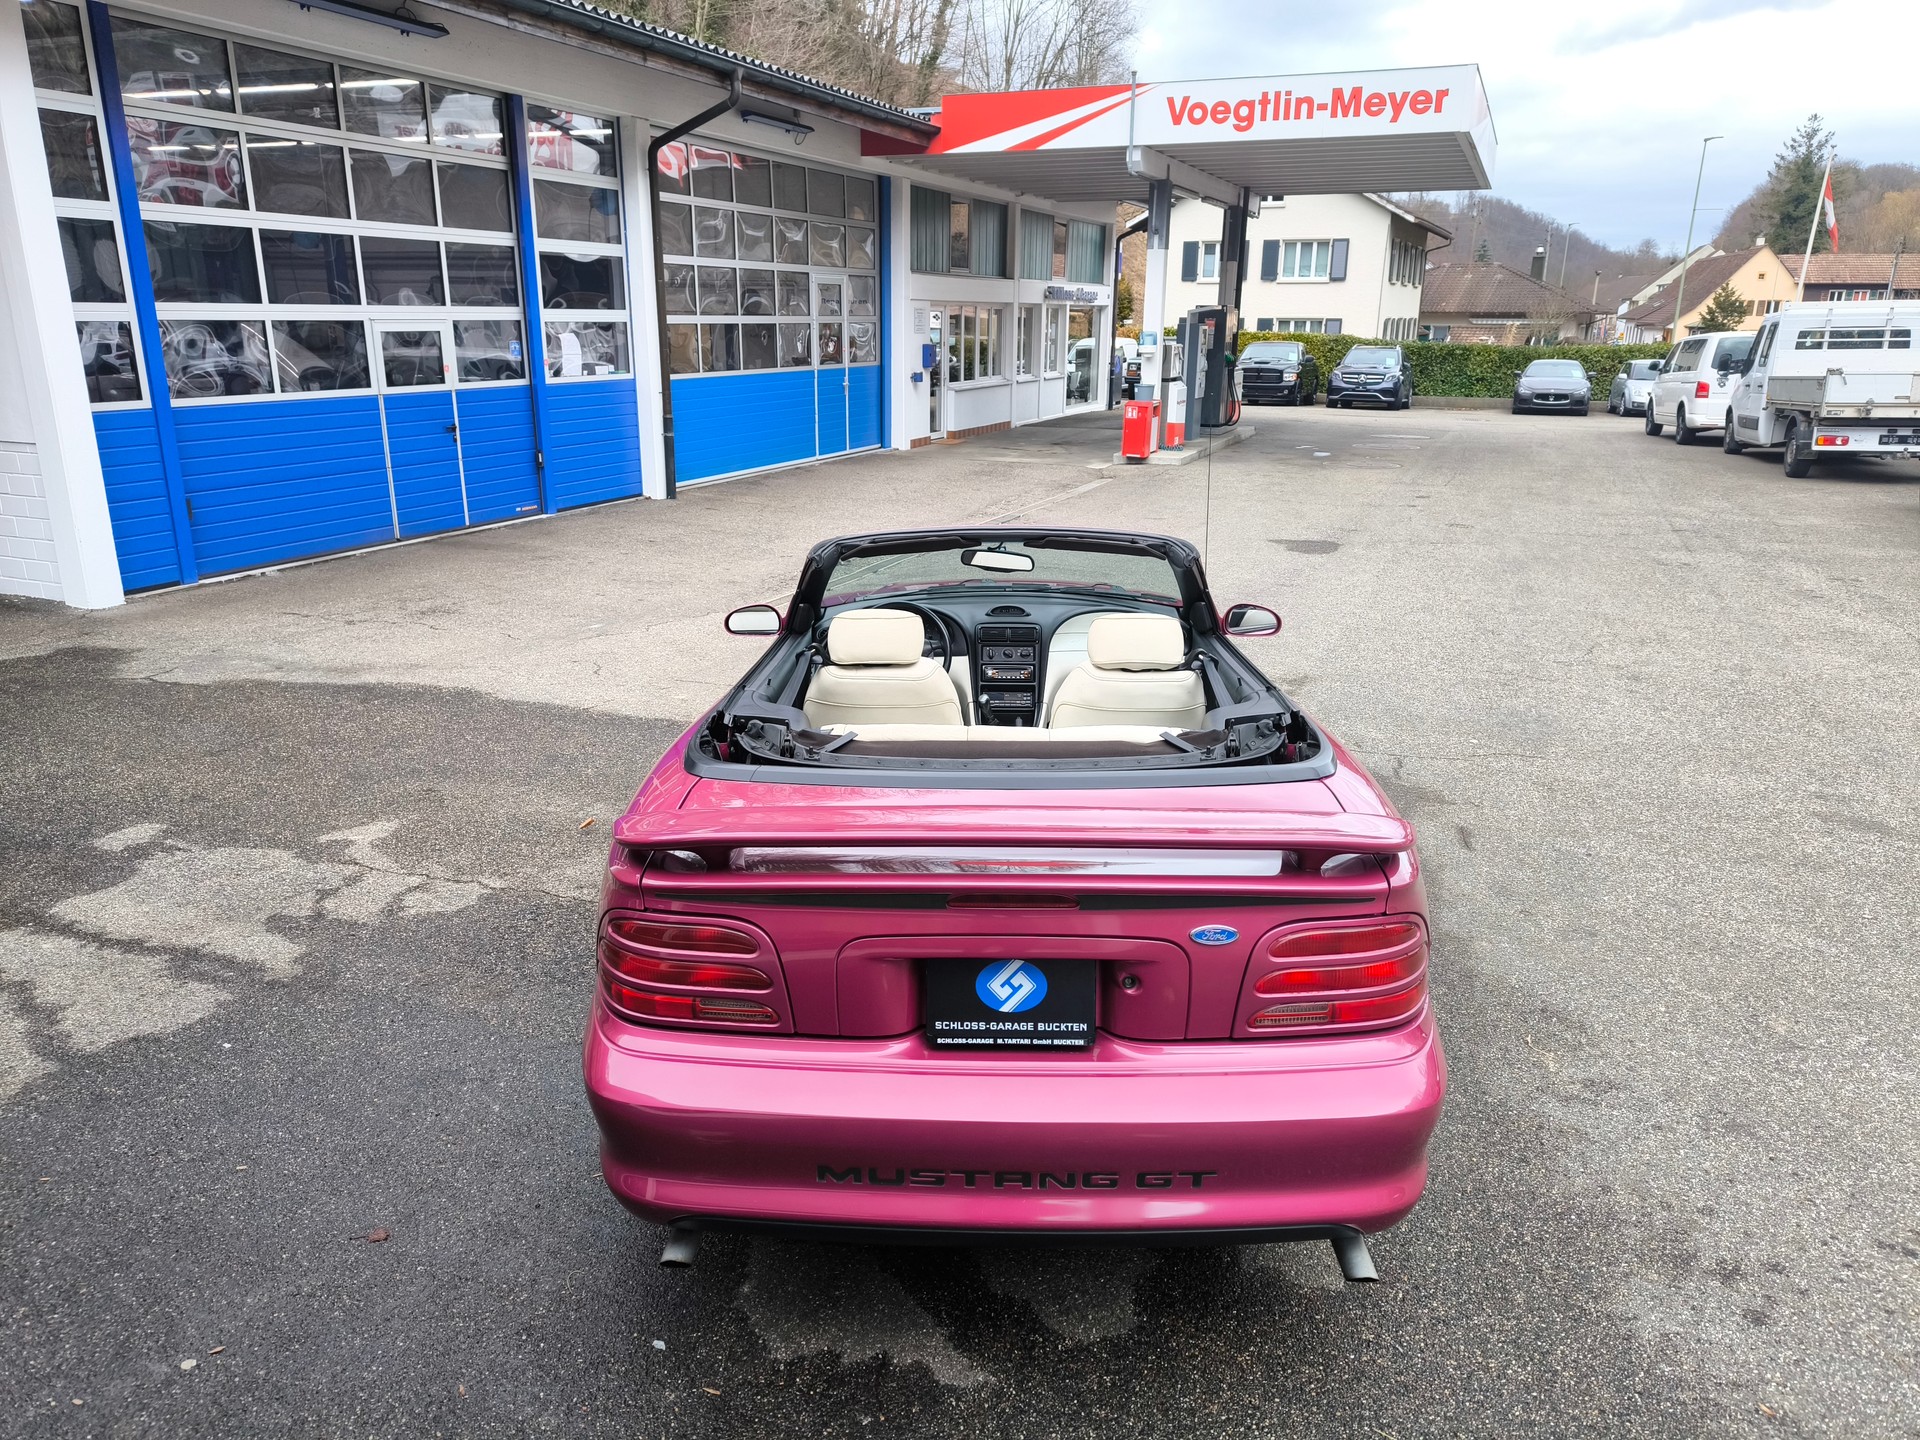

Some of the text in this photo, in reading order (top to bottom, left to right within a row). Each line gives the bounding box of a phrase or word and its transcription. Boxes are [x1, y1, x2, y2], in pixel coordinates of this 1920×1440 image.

[1166, 86, 1450, 132] Voegtlin-Meyer
[1201, 928, 1229, 941] Ford
[935, 1021, 1088, 1032] SCHLOSS-GARAGE BUCKTEN
[816, 1164, 1218, 1190] MUSTANG GT
